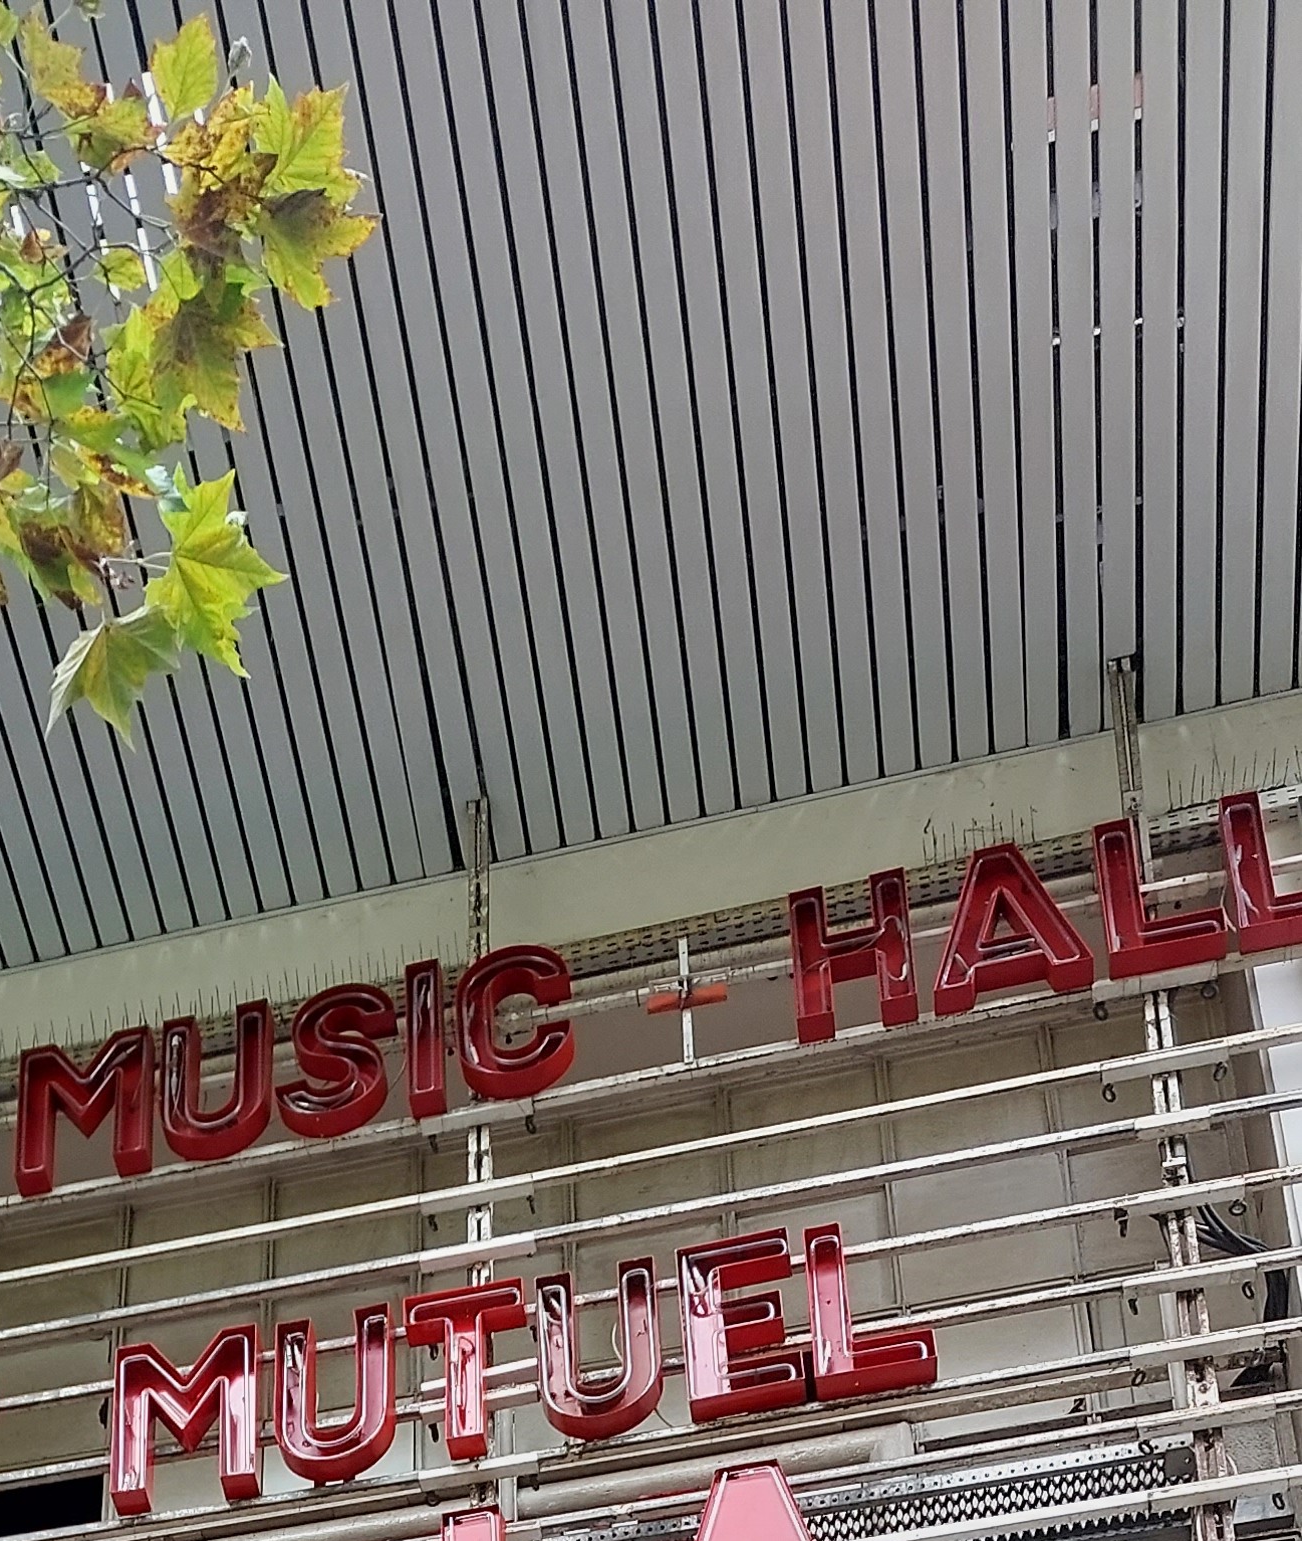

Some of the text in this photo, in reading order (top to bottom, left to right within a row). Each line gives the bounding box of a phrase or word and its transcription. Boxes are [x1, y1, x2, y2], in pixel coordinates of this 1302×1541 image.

[15, 944, 576, 1197] MUSIC
[788, 791, 1302, 1044] HALL
[109, 1222, 938, 1517] MUTUEL
